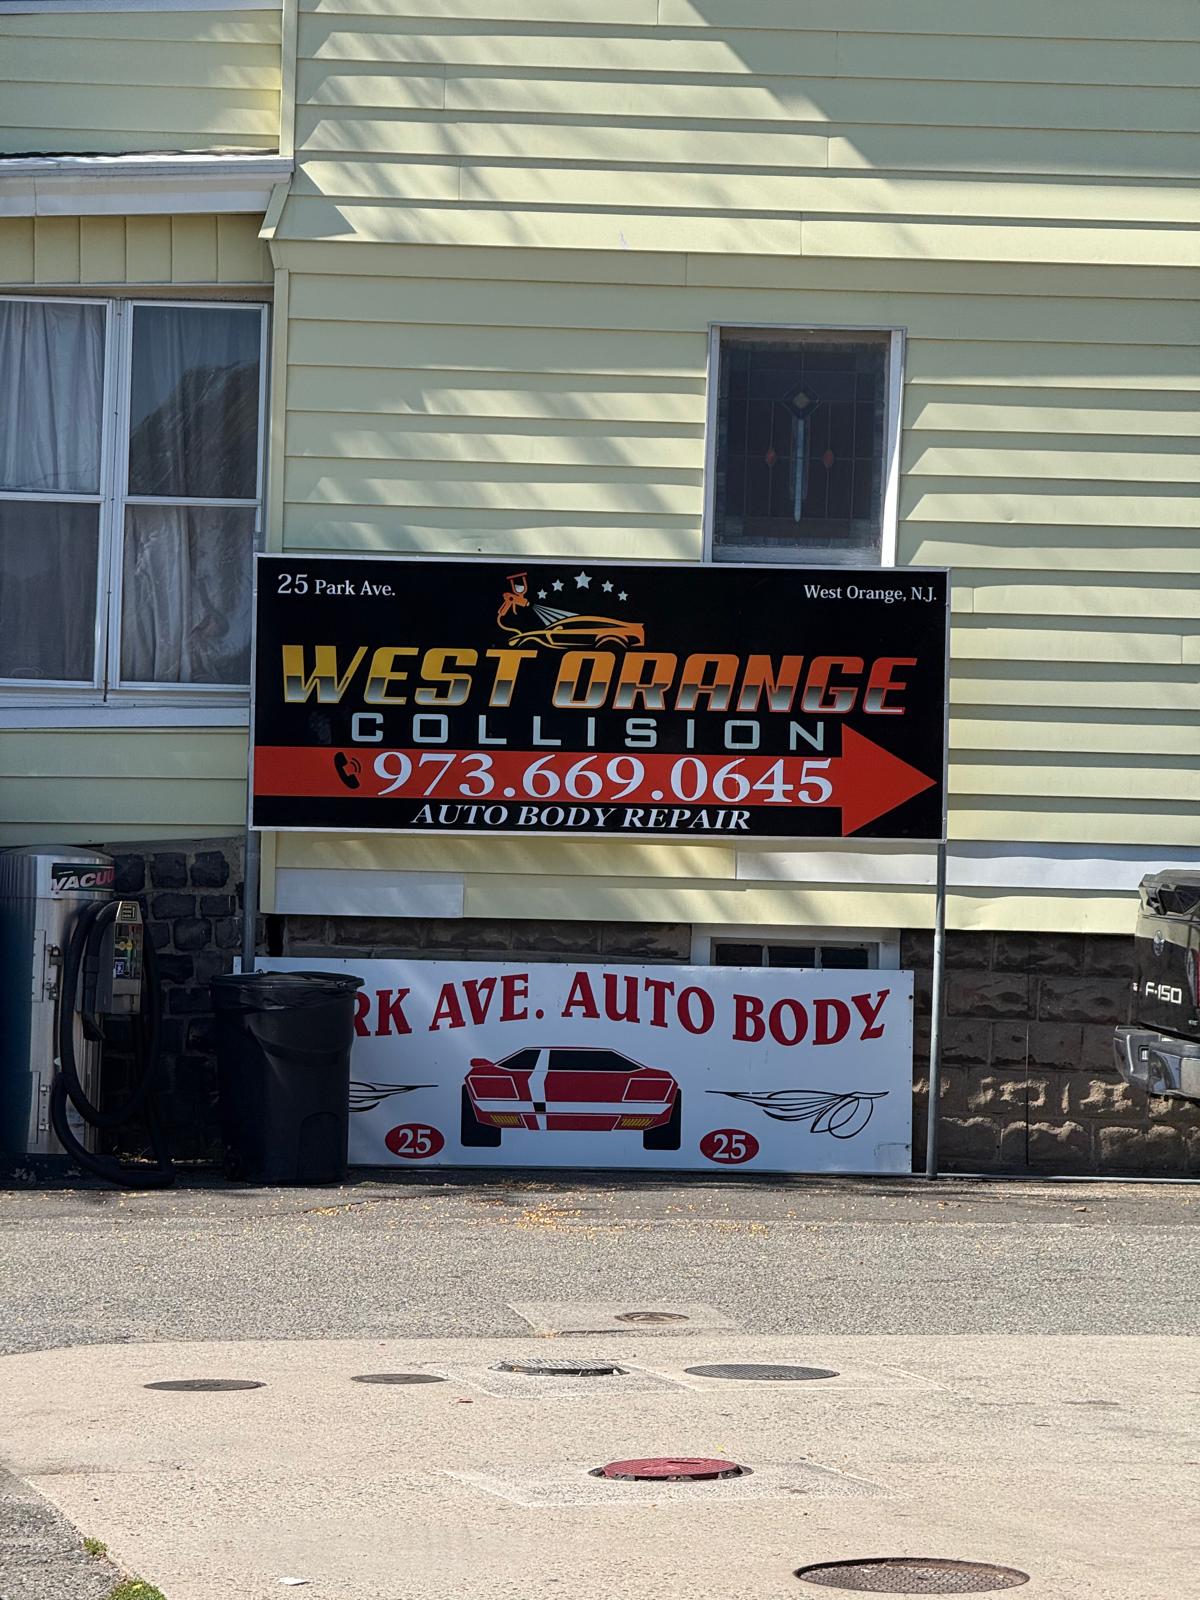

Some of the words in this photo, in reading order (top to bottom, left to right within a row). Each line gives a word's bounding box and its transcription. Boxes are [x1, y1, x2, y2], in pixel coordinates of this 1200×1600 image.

[277, 573, 309, 595] 25
[314, 579, 356, 595] Park
[360, 580, 396, 597] Ave.
[804, 584, 843, 599] West
[846, 585, 907, 604] Orange,
[911, 586, 937, 603] N.J.
[282, 644, 538, 707] WEST
[552, 650, 918, 715] ORANGE
[351, 712, 824, 751] COLLISION
[373, 751, 833, 804] 973.669.0645
[411, 803, 507, 825] AUTO
[515, 805, 617, 828] BODY
[621, 808, 751, 830] REPAIR
[1145, 981, 1182, 1005] F-150
[428, 973, 544, 1031] AVE.
[561, 971, 715, 1035] AUTO
[732, 989, 890, 1046] BODY
[398, 1129, 431, 1154] 25
[713, 1134, 747, 1159] 25
